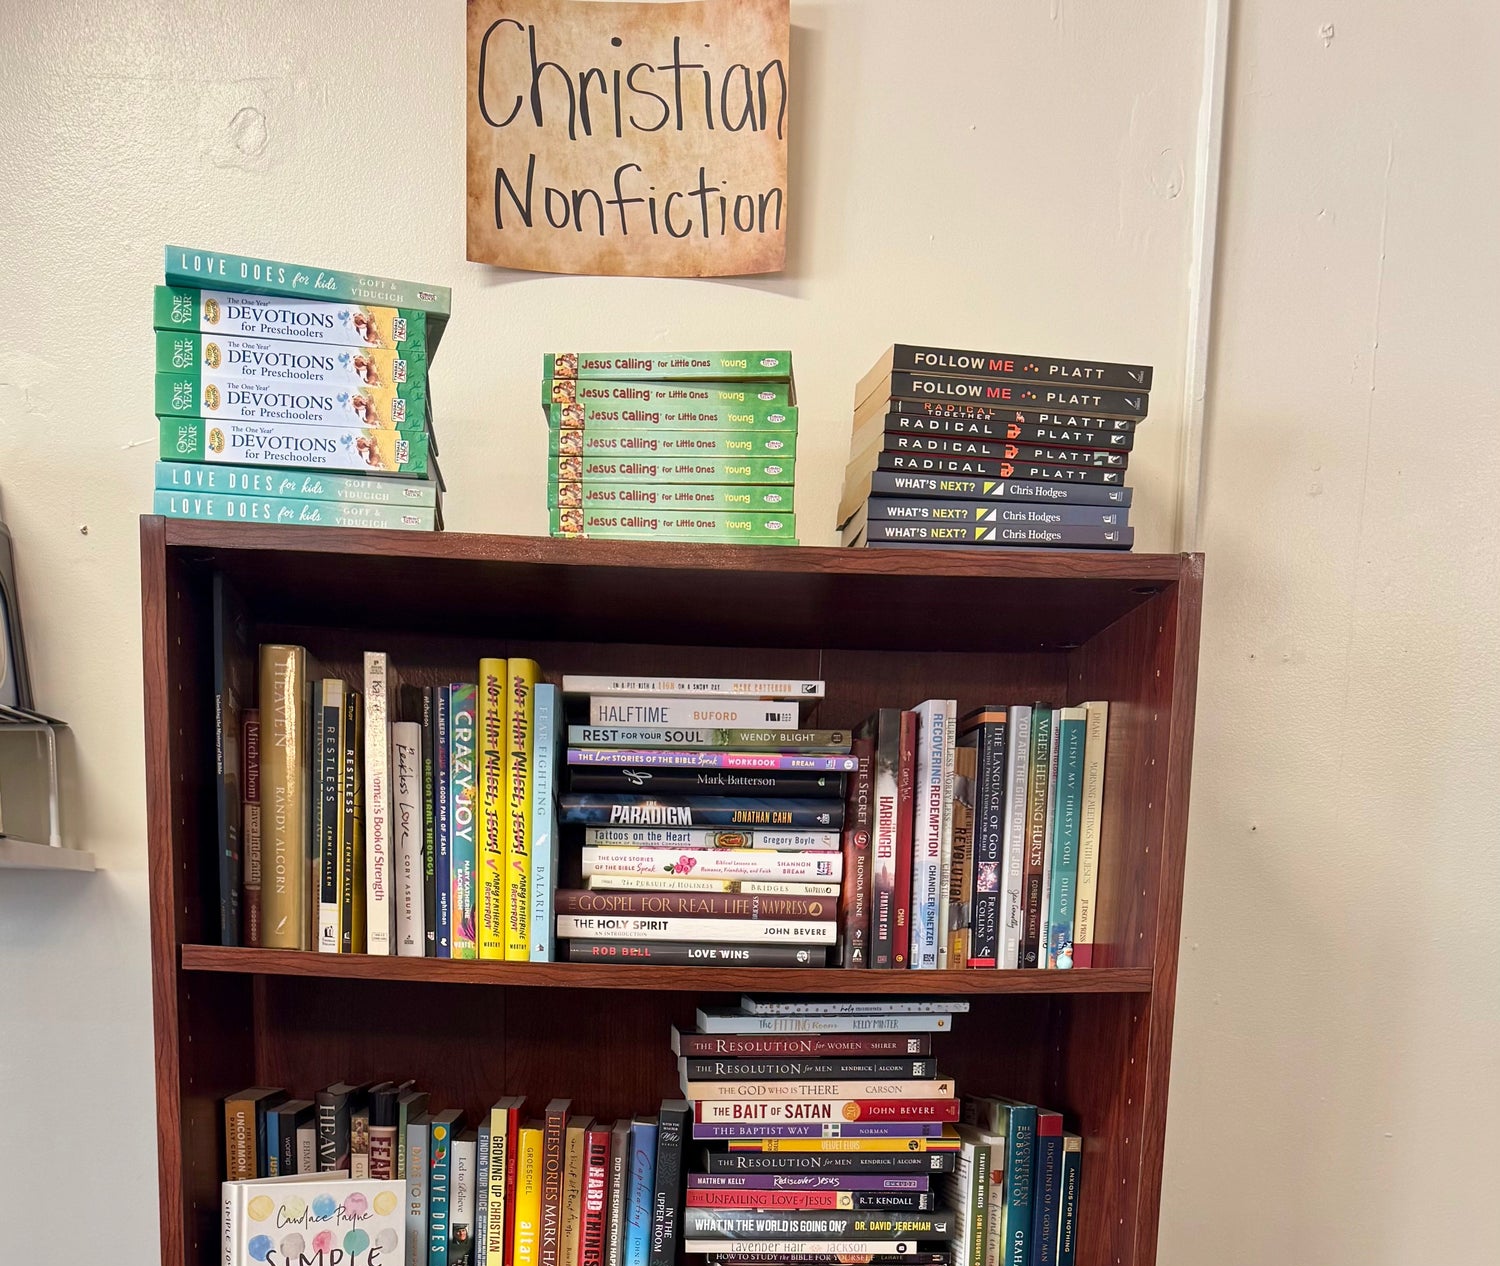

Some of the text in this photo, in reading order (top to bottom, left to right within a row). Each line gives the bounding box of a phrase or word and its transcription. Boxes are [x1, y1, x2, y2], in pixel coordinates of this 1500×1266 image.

[478, 18, 787, 141] Christian
[494, 154, 783, 238] Nonfiction
[182, 254, 337, 290] LOVE DOES for kids
[227, 307, 334, 328] DEVOTIONS
[241, 322, 324, 338] for Preschoolers
[228, 350, 334, 371] DEVOTIONS
[582, 360, 612, 369] Jesus
[670, 359, 690, 367] Little
[692, 359, 710, 367] Ones
[720, 359, 747, 368] Young
[914, 353, 1105, 379] FOLLOW ME PLATT
[227, 392, 333, 410] DEVOTIONS
[900, 418, 1094, 442] RADICAL PLATT
[231, 435, 336, 452] DEVOTIONS
[895, 478, 1067, 498] WHAT'S NEXT? Chris Hodges
[599, 706, 737, 722] HALFTIME BUFORD
[583, 730, 618, 741] REST
[640, 732, 661, 740] YOUR
[665, 731, 704, 742] SOUL
[740, 732, 776, 741] WENDY
[780, 734, 814, 742] BLIGHT
[326, 726, 335, 802] RESTLESS
[728, 759, 775, 767] WORKBOOK
[455, 711, 472, 842] CRAZY JOY
[610, 806, 792, 826] PARADIGM JONATHAN CAHN
[878, 796, 894, 858] HARBINGER
[925, 713, 944, 946] RECOVERING REDEMPTION CHANDLER/SNETZER
[594, 830, 630, 841] Tattoos
[666, 832, 690, 842] Heart
[763, 836, 792, 845] Gregory
[796, 836, 814, 845] Boyle
[1031, 824, 1043, 866] HURTS
[574, 919, 826, 936] THE HOLY SPIRIT JOHN BEVERE
[592, 947, 749, 960] ROB BELL LOVE WINS
[717, 1039, 812, 1052] RESOLUTION
[814, 1041, 826, 1050] for
[713, 1107, 730, 1117] THE
[733, 1104, 768, 1119] BAIT
[771, 1107, 781, 1116] OF
[785, 1104, 831, 1119] SATAN
[900, 1106, 935, 1114] BEVERE
[713, 1127, 735, 1135] THE
[739, 1127, 784, 1135] BAPTIST
[237, 1111, 245, 1174] UNCOMMON
[489, 1136, 503, 1252] GROWING UP CHRISTIAN
[276, 1203, 373, 1231] Candace Payne
[433, 1161, 446, 1253] LOVE DOES
[855, 1222, 931, 1231] DR. DAVID JEREMIAH
